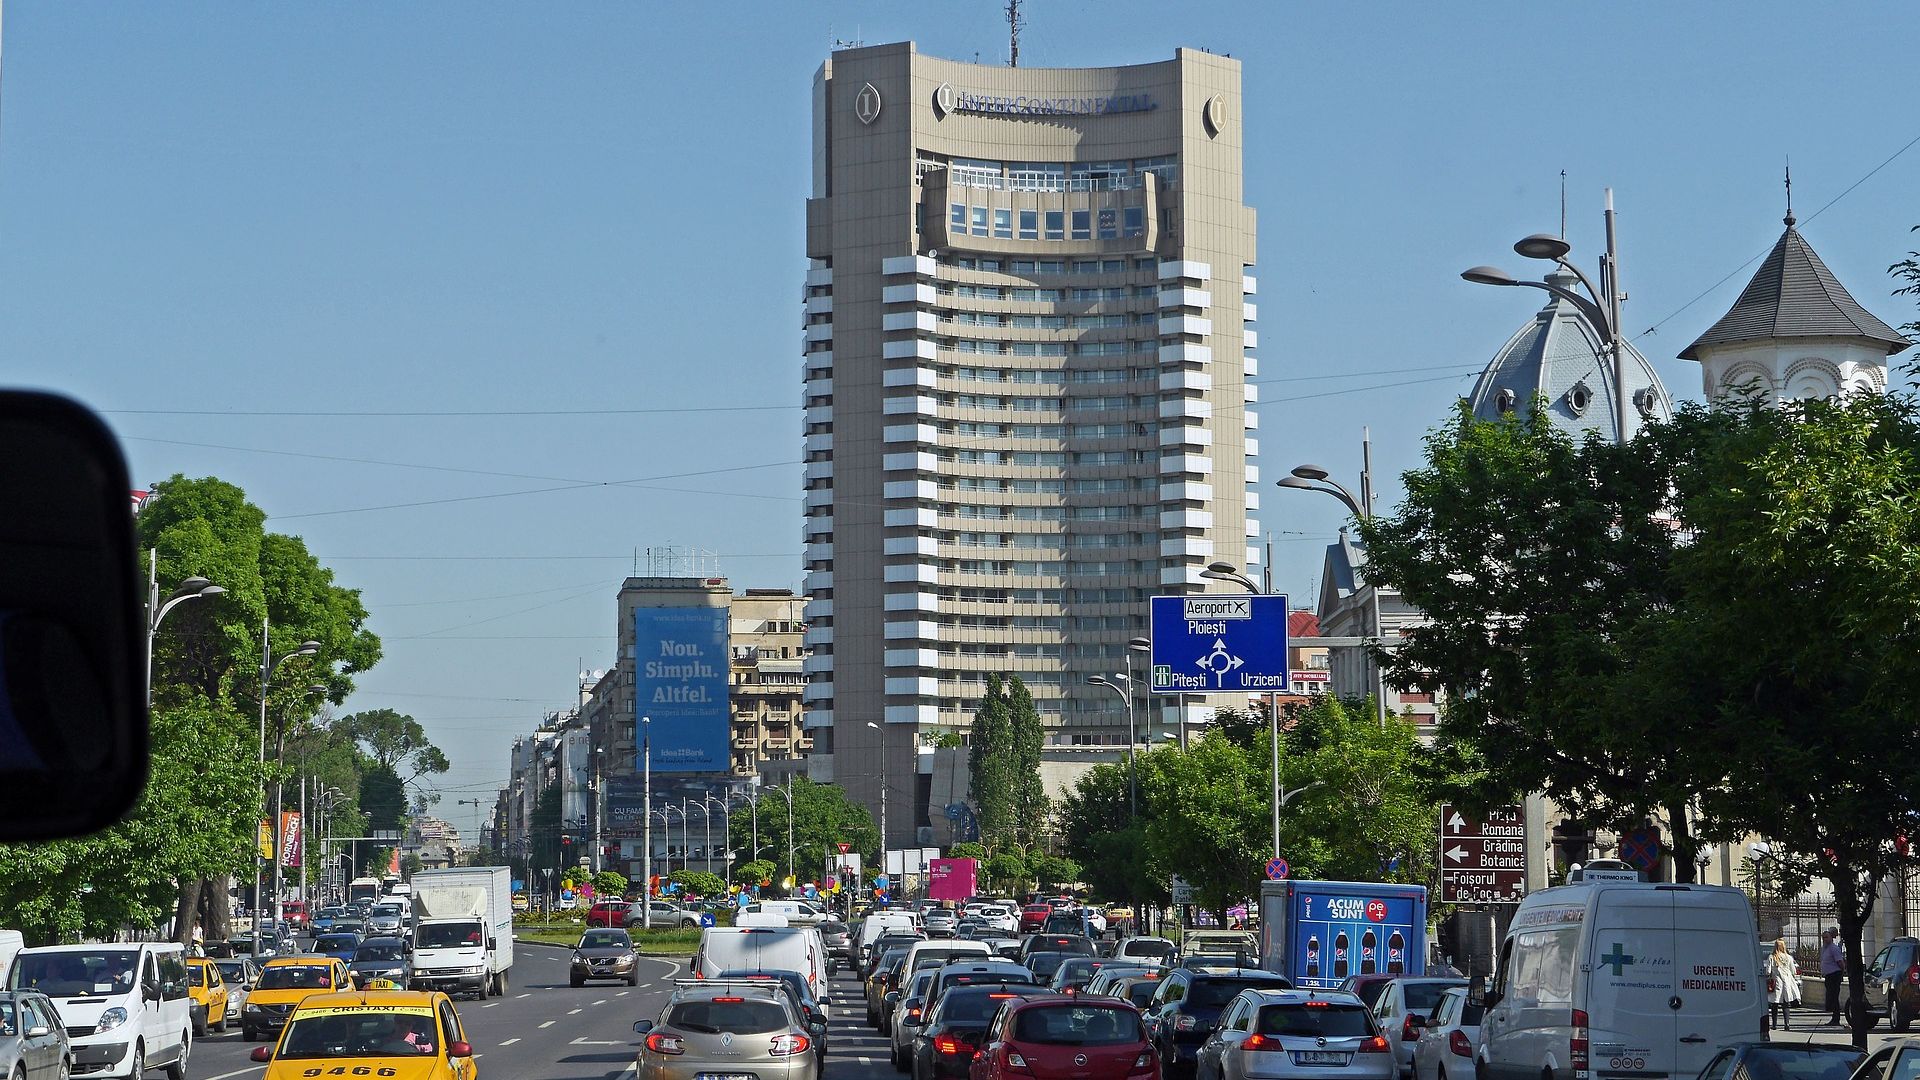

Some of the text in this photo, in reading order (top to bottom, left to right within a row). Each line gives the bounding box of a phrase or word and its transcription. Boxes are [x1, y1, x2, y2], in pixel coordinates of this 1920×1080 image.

[1186, 600, 1232, 617] Aeroport
[1188, 620, 1226, 637] Ploiești
[661, 640, 704, 657] Nou.
[645, 661, 719, 682] Simplu.
[1171, 673, 1206, 689] Pitești
[1240, 672, 1283, 687] Urziceni
[652, 685, 713, 703] Altfel.
[1481, 822, 1524, 836] Română
[281, 816, 300, 867] HORNBACH
[1483, 840, 1523, 853] Grădina
[1480, 854, 1524, 867] Botanică
[1453, 872, 1496, 887] Foișorul
[1456, 887, 1469, 899] de
[1327, 898, 1364, 910] ACUM
[1368, 902, 1384, 913] pe
[1331, 908, 1365, 920] SUNT
[375, 980, 388, 989] TAXI
[1609, 981, 1671, 990] www.mediplus.com
[1682, 979, 1746, 992] MEDICAMENTE
[302, 1066, 397, 1078] 9466
